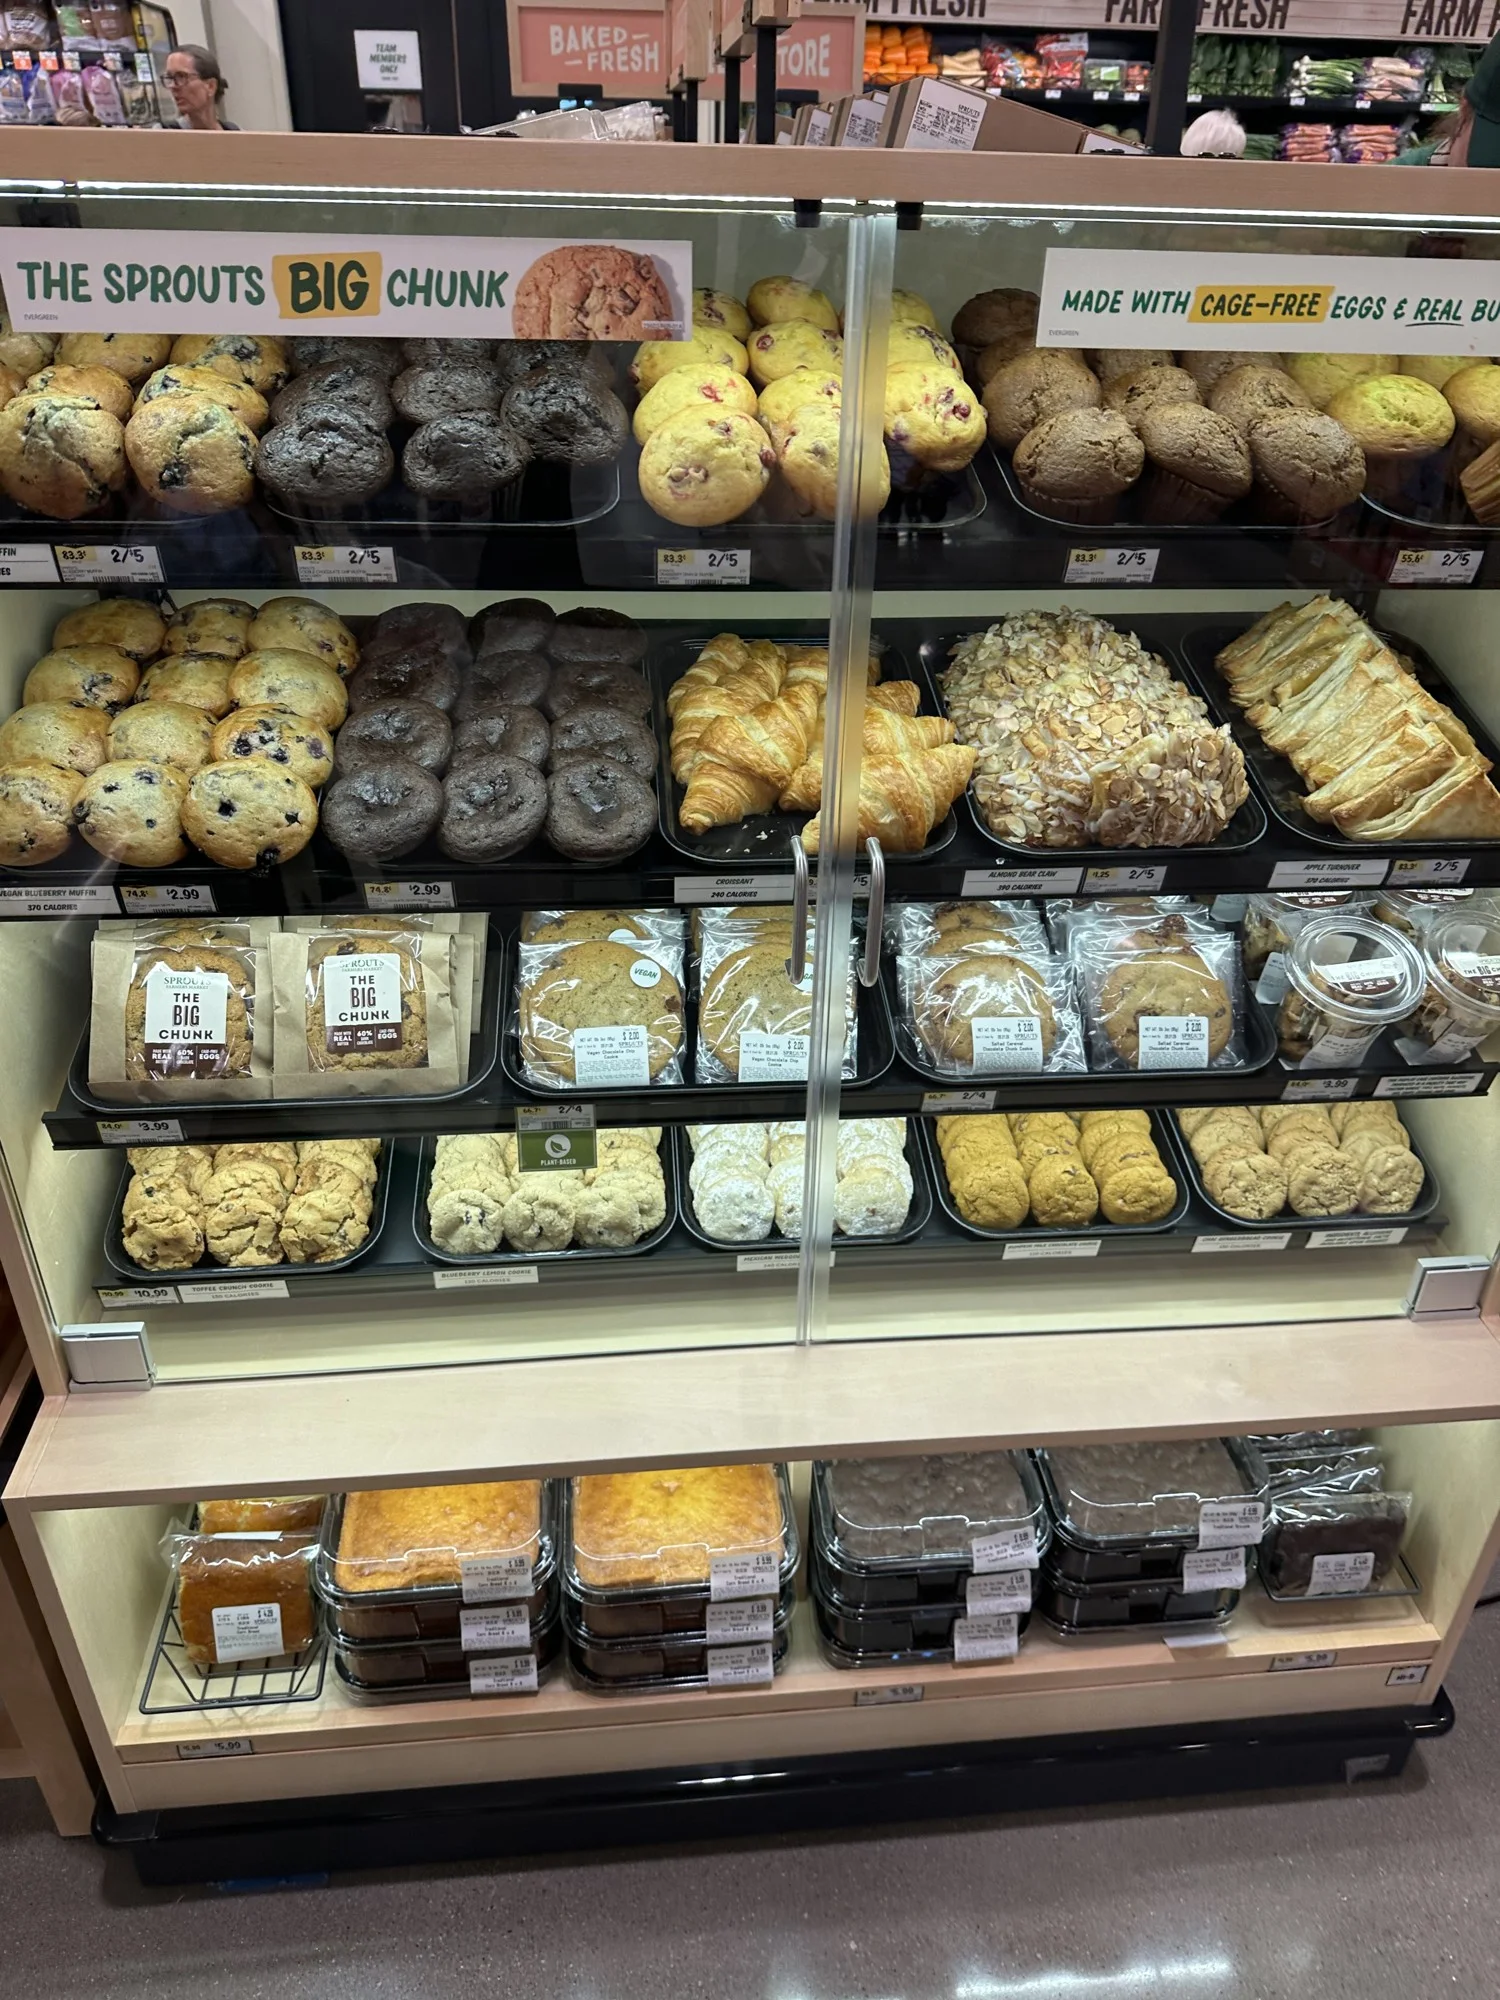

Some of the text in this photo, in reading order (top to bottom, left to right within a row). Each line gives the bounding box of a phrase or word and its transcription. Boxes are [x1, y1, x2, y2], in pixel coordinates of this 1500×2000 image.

[1401, 0, 1483, 36] FARM
[550, 24, 627, 56] BAKED
[375, 43, 397, 53] TEAM
[369, 53, 407, 64] MEMBERS
[586, 42, 660, 73] FRESH
[379, 64, 398, 73] ONLY
[17, 260, 509, 313] THE SPROUTS BIG CHUNK
[1061, 290, 1124, 314] MADE
[1131, 290, 1192, 314] WITH
[1200, 292, 1322, 317] CAGE-FREE
[1330, 295, 1387, 320] EGGS
[1393, 298, 1408, 320] &
[1413, 297, 1463, 322] REAL
[111, 548, 145, 563] 2/$5
[348, 549, 381, 564] 2/$5
[708, 553, 738, 567] 2/$5
[1117, 552, 1146, 565] 2/$5
[1441, 553, 1471, 566] 2/$5
[1129, 870, 1155, 879] 2/$5
[25, 889, 67, 897] BLUEBERRY
[166, 888, 200, 899] $2.99
[409, 885, 440, 895] $2.99
[43, 903, 78, 911] CALORIES
[634, 967, 657, 979] VEGAN
[1477, 965, 1491, 975] BIG
[350, 975, 375, 984] THE
[174, 993, 199, 1002] THE
[351, 987, 376, 1008] BIG
[172, 1005, 200, 1026] BIG
[339, 1010, 390, 1022] CHUNK
[159, 1030, 213, 1040] CHUNK
[139, 1122, 169, 1131] $3.99
[134, 1289, 168, 1298] $10.99
